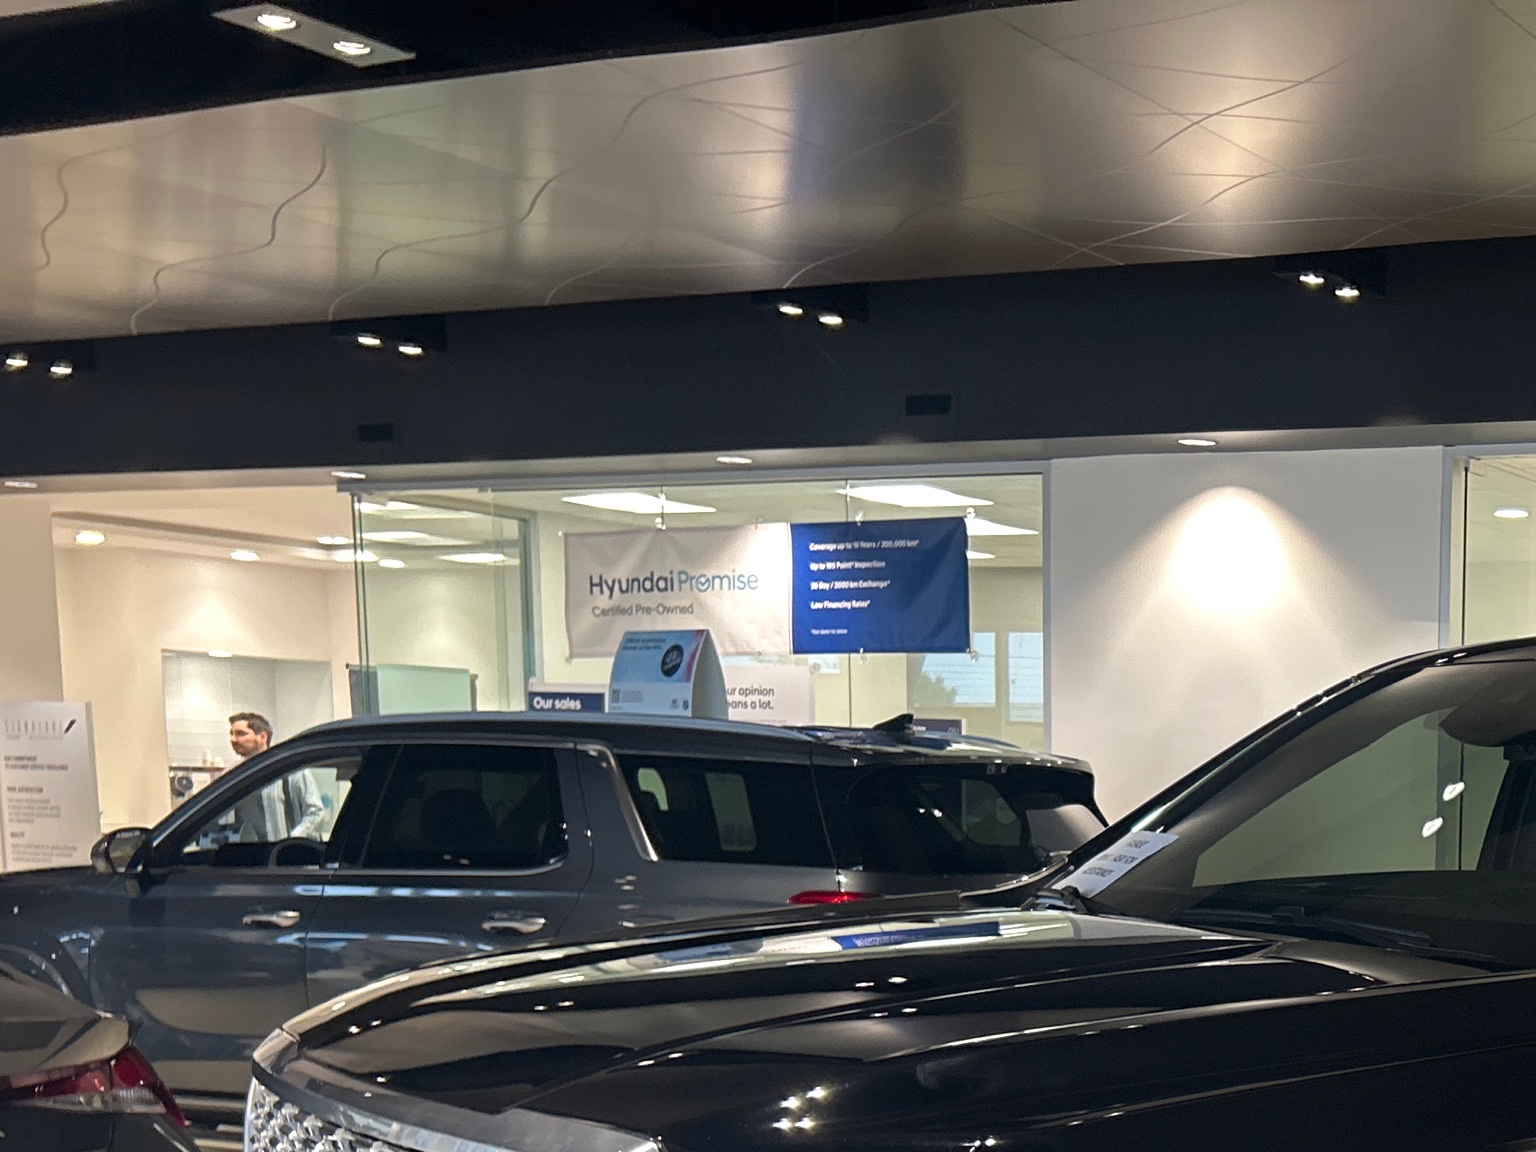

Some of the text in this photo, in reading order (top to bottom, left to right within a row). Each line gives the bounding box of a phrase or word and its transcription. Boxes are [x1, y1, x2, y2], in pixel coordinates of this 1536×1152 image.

[589, 569, 759, 599] Hyundai Promise
[592, 602, 694, 618] Certified Pre-Owned
[727, 684, 775, 698] ur opinion
[533, 696, 581, 710] Our sales
